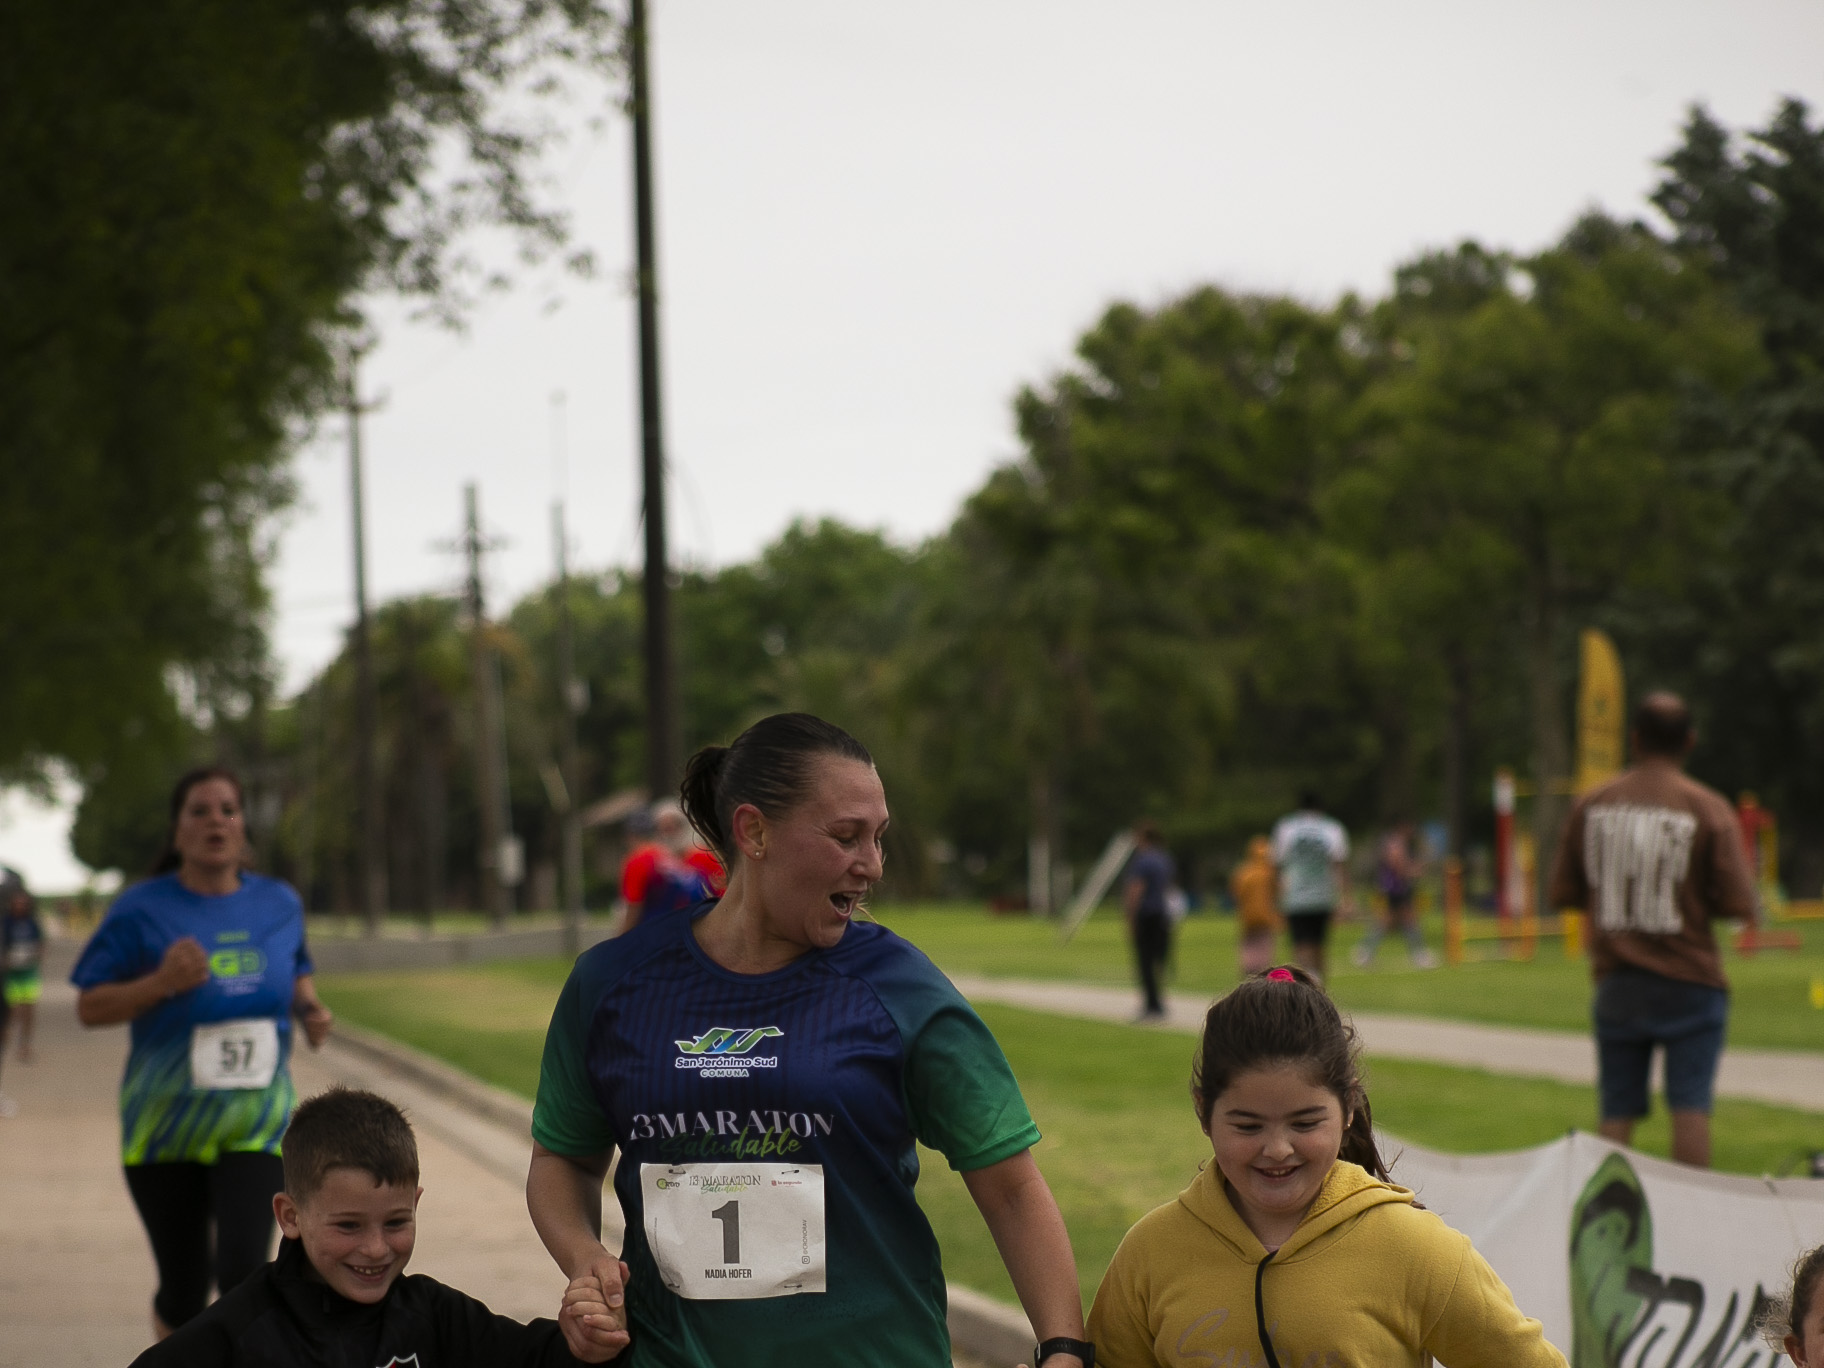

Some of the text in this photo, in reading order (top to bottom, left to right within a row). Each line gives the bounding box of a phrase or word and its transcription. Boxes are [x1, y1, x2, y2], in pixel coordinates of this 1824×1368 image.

[221, 1038, 255, 1073] 57
[675, 1056, 778, 1069] San Jerónimo Sud
[700, 1068, 750, 1078] COMUNA
[658, 1110, 835, 1138] MARATON
[660, 1126, 802, 1159] Saludable
[702, 1174, 761, 1186] MARATON
[701, 1183, 749, 1194] Saludable
[711, 1200, 741, 1265] 1
[705, 1268, 752, 1279] NADIA HOFER
